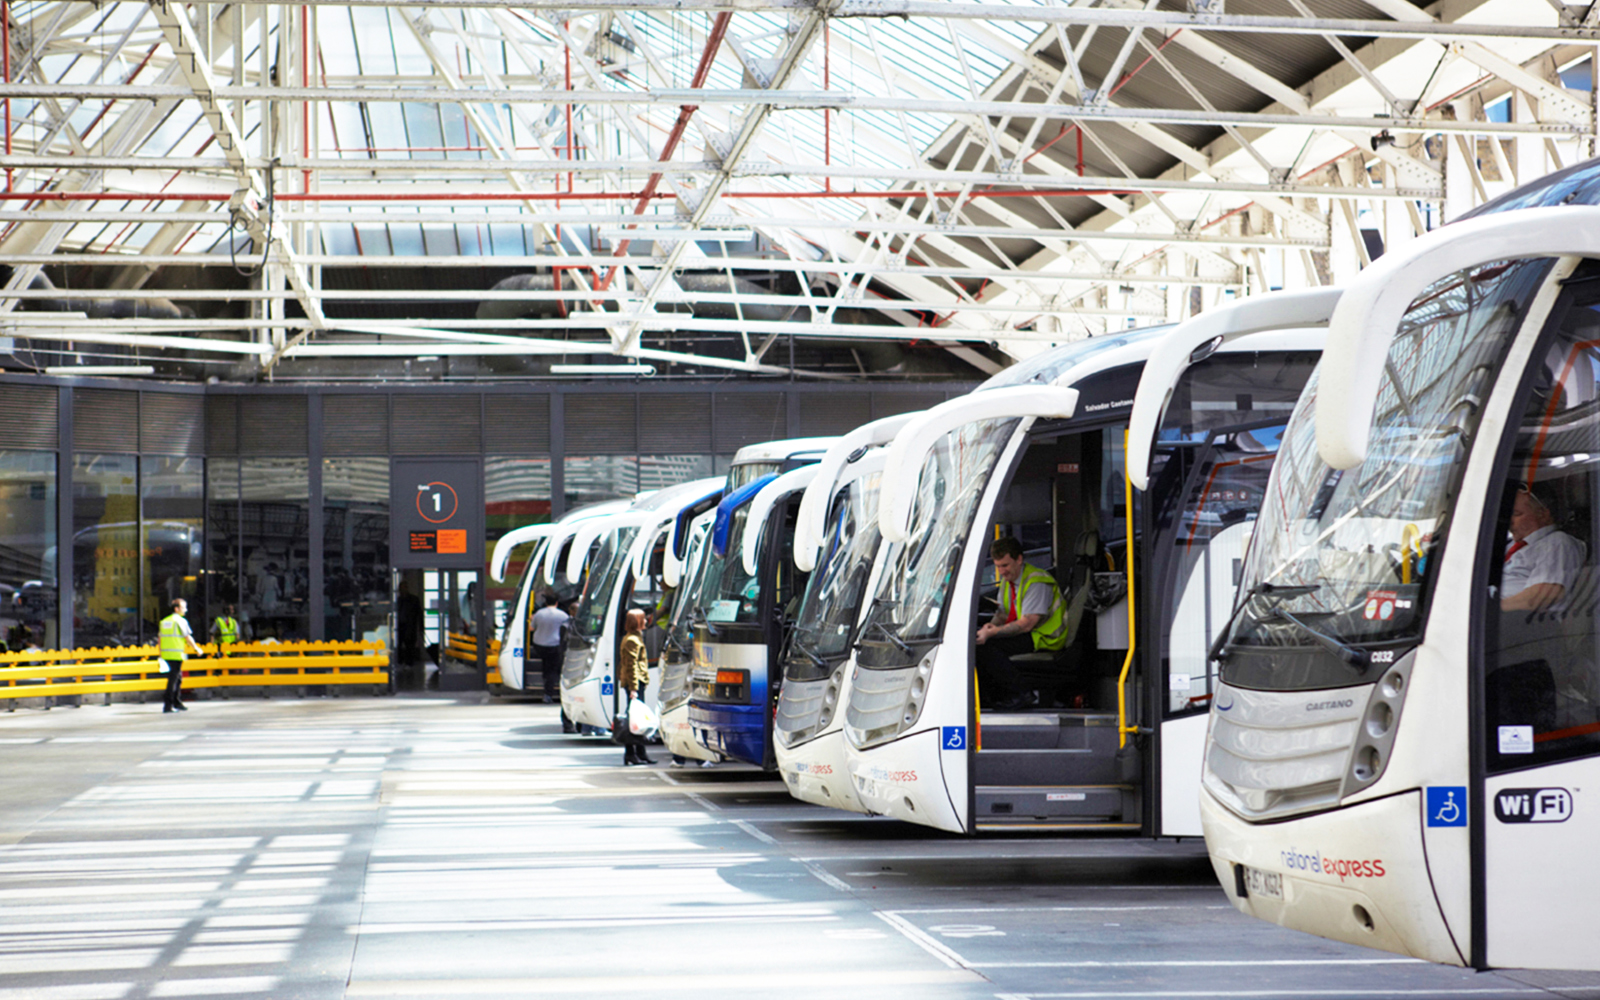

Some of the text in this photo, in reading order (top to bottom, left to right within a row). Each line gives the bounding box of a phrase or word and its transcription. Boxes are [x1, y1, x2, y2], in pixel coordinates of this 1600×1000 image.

[432, 493, 441, 512] 1
[1306, 699, 1354, 711] CAETANO
[1281, 847, 1386, 883] national express
